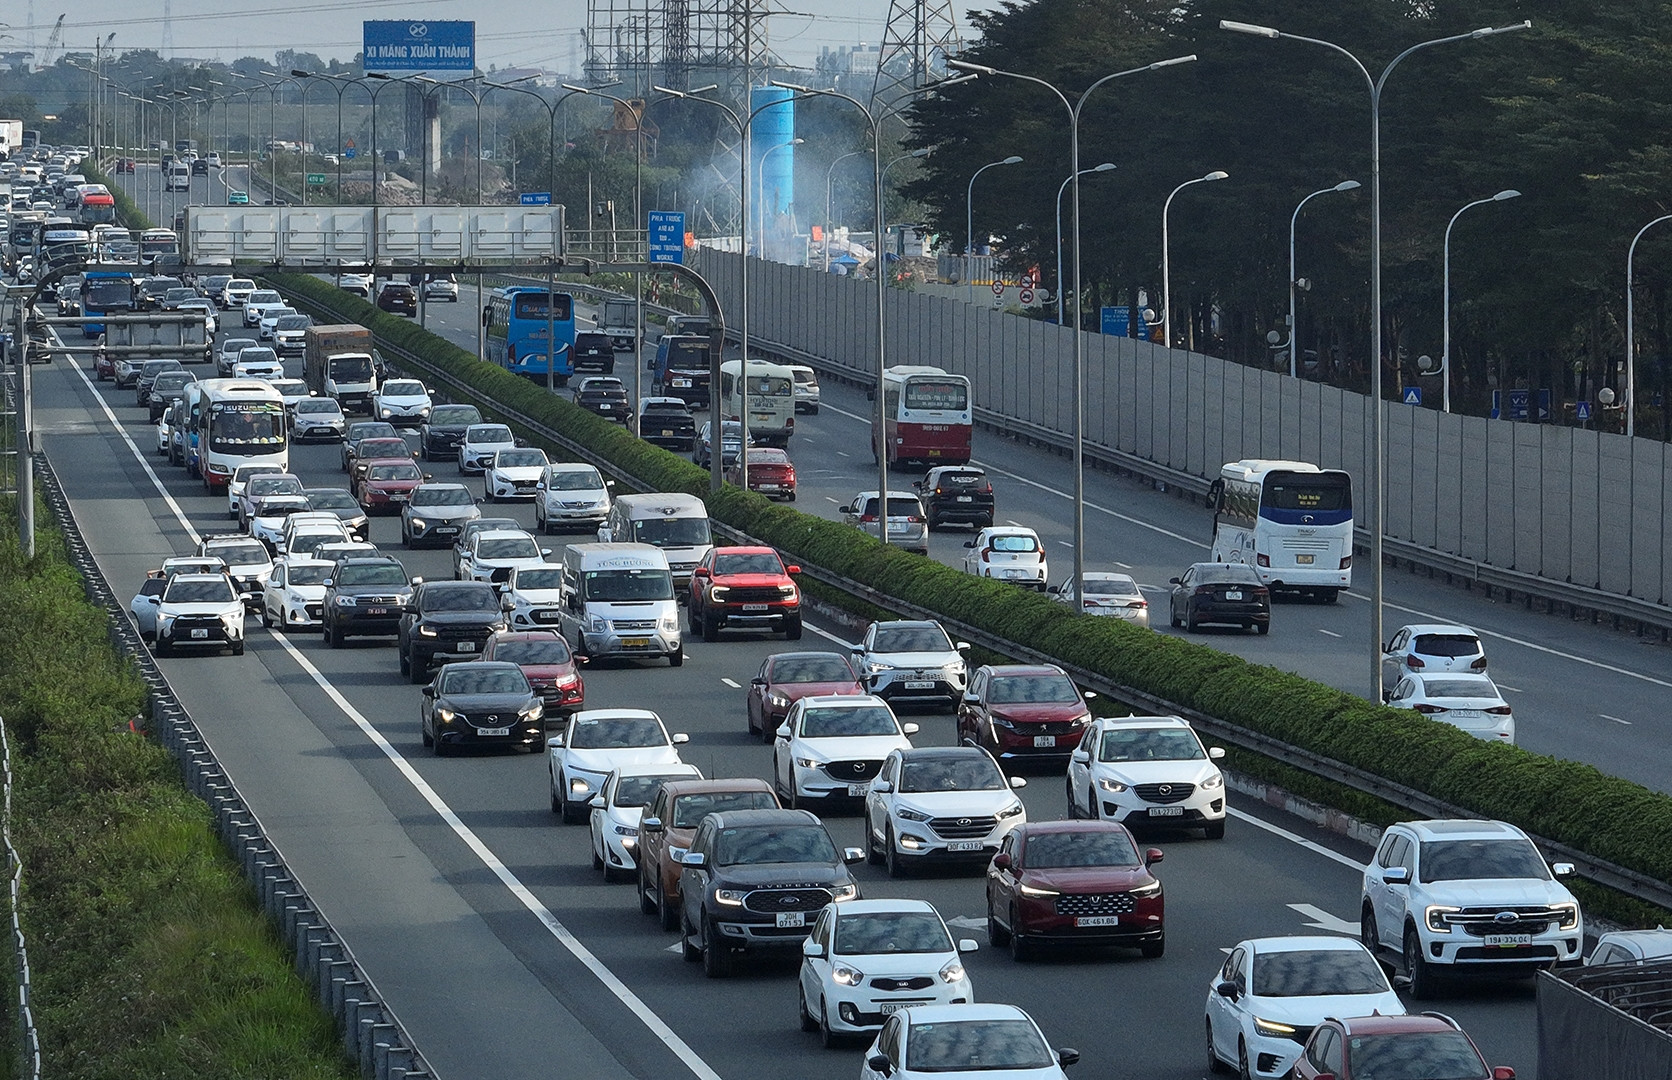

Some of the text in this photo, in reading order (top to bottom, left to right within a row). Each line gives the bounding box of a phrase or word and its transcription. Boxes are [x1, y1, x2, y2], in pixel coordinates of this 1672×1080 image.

[367, 43, 470, 58] XI MĂNG XUÂN THÀNH
